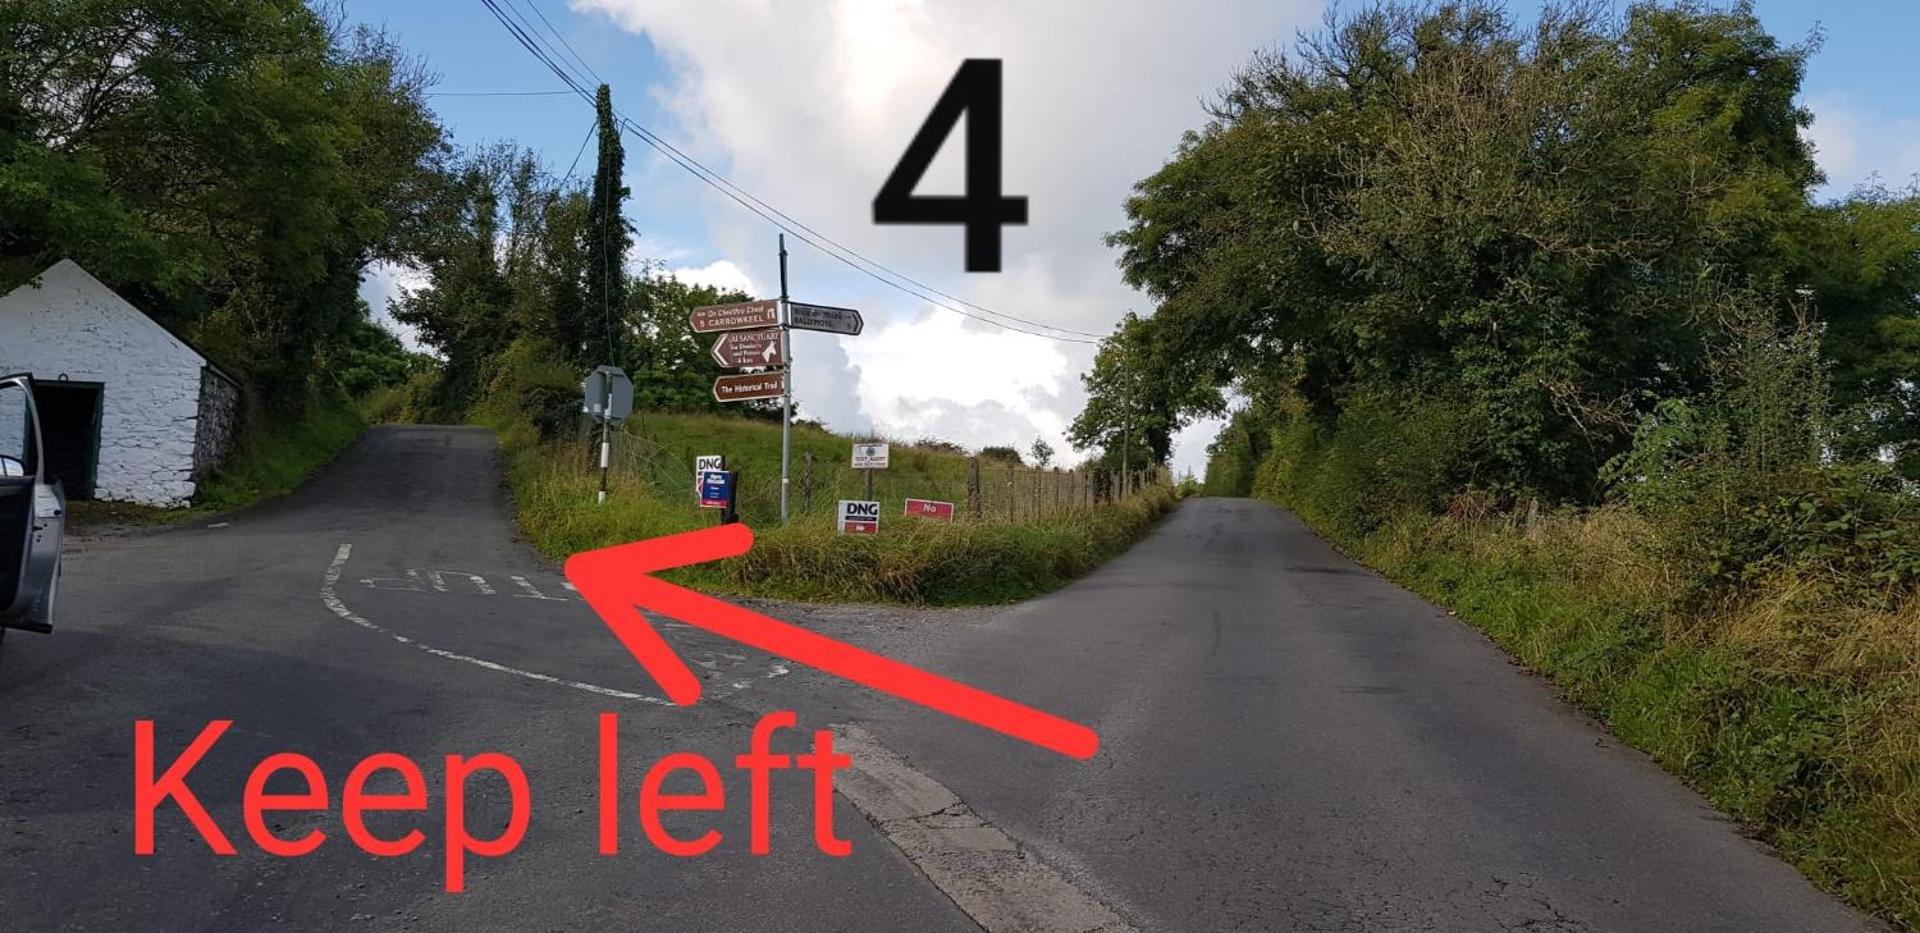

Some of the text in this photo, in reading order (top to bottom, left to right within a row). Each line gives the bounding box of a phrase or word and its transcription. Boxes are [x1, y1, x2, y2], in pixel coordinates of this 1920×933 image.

[708, 315, 764, 326] CARROWKEEL
[721, 381, 778, 394] The Historical Trail
[699, 458, 721, 470] DNG
[847, 503, 878, 516] DNG
[923, 504, 937, 513] No
